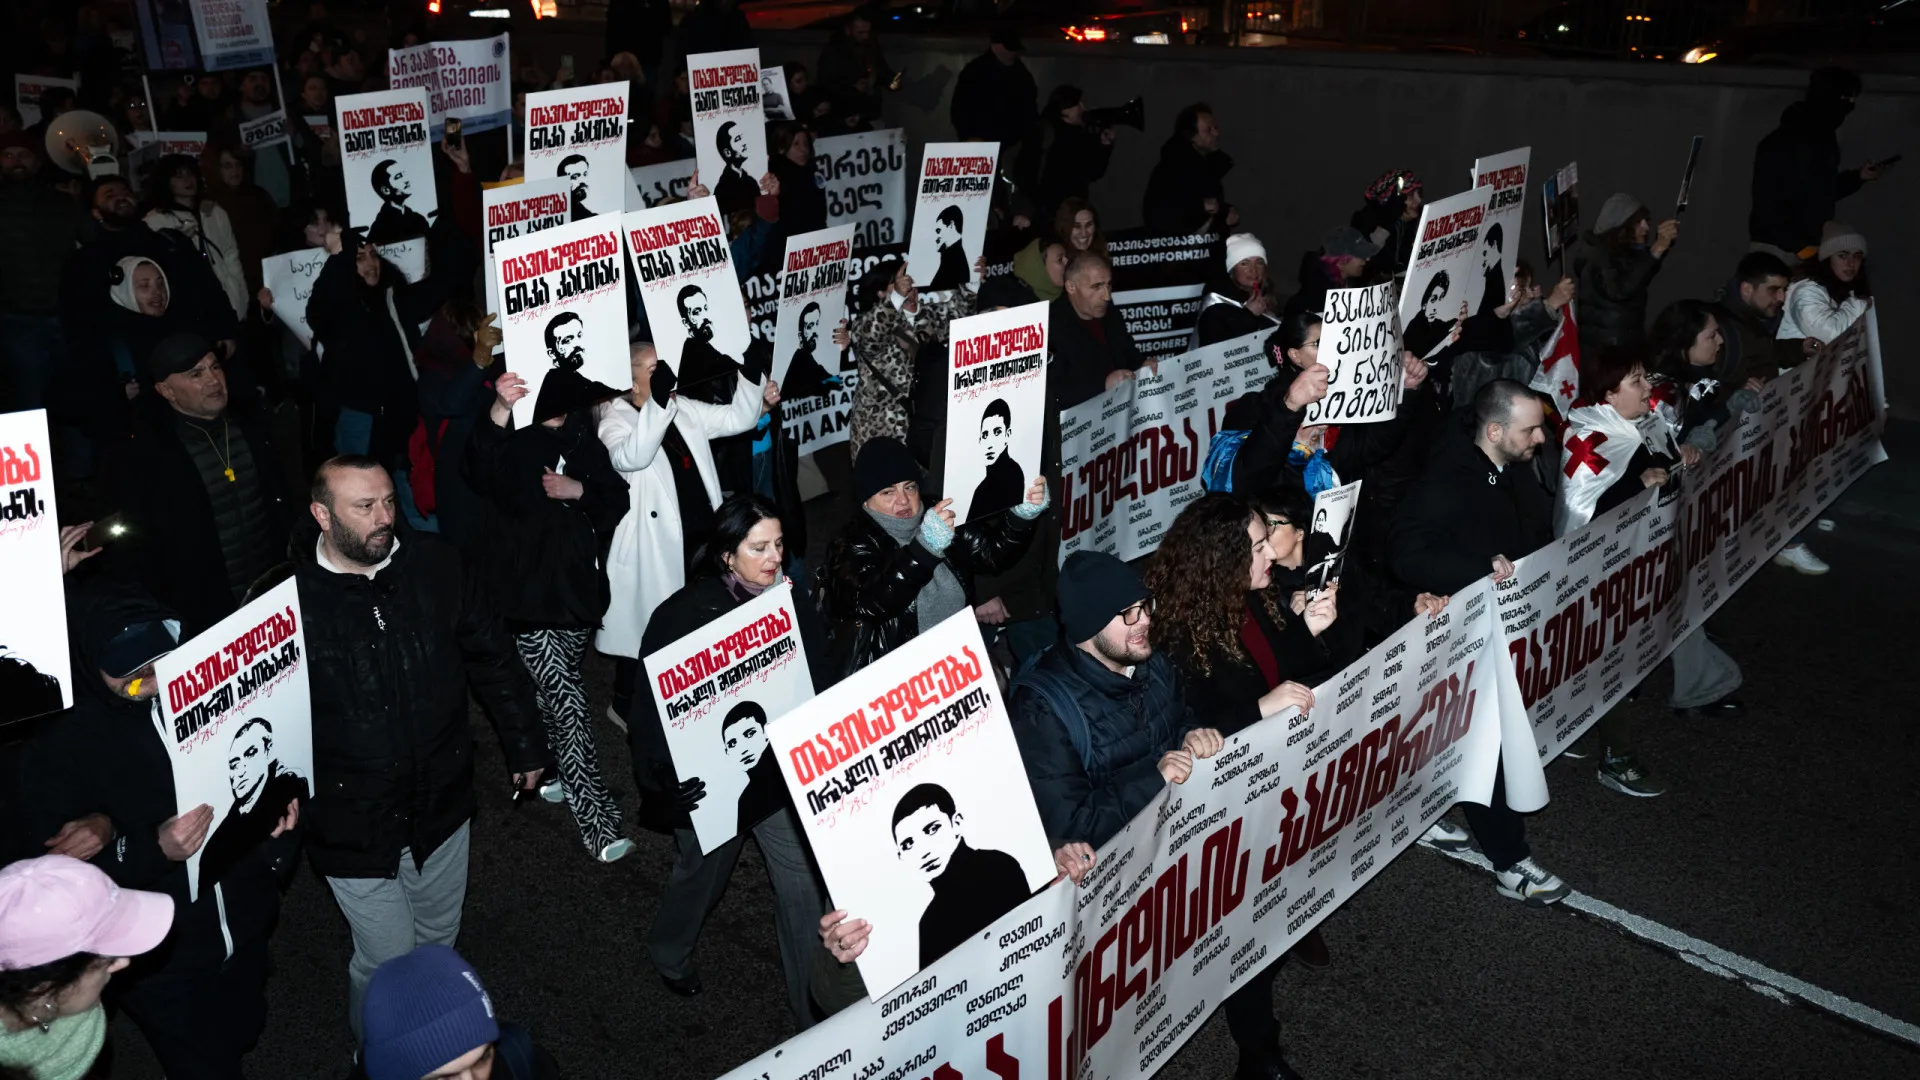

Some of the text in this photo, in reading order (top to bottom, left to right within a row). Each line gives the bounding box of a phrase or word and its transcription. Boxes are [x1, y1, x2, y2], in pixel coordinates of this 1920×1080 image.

[392, 53, 409, 76] არ
[441, 64, 501, 88] რეჟიმის
[692, 63, 759, 89] თავისუფლება
[343, 101, 425, 131] თავისუფლება
[530, 96, 625, 127] თავისუფლება
[694, 90, 720, 112] მათე
[344, 130, 376, 153] მათე
[530, 125, 566, 150] ნიკა
[925, 156, 994, 176] თავისუფლება
[828, 183, 882, 217] ბელ
[922, 177, 954, 193] გიორგი
[488, 192, 567, 227] თავისუფლება
[1422, 203, 1486, 243] თავისუფლება
[630, 213, 721, 254] თავისუფლება
[502, 231, 618, 284] თავისუფლება
[637, 250, 676, 282] ნიკა
[787, 238, 850, 272] თავისუფლება
[1111, 249, 1211, 267] REEDOMFORMZIA
[505, 277, 550, 315] ნიკა
[784, 270, 809, 298] ნიკა
[1125, 318, 1172, 334] რებს!
[954, 322, 1044, 369] თავისუფლება
[1135, 337, 1188, 353] RISONERS
[1224, 345, 1250, 359] ფრიდონ
[954, 366, 988, 390] ირაკლი
[1185, 360, 1202, 372] დავით
[1186, 368, 1214, 384] კოლდარი
[1138, 375, 1164, 388] გიორგი
[1174, 388, 1196, 402] დანიელ
[1213, 376, 1231, 388] რეზო
[781, 394, 836, 422] UMELEBI
[1061, 417, 1198, 541] სუფლება
[1138, 521, 1162, 537] ირაკლი
[1425, 613, 1450, 636] გიორგი
[1509, 530, 1684, 709] თავისუფლება
[657, 606, 792, 700] თავისუფლება
[1384, 640, 1407, 663] ანტონ
[1426, 629, 1452, 654] მინდაძე
[168, 605, 297, 714] თავისუფლება
[1338, 666, 1371, 698] ანატოლი
[1372, 682, 1398, 706] ანდრო
[174, 683, 234, 743] გიორგი
[666, 679, 717, 721] ირაკლი
[789, 645, 983, 786] თავისუფლება
[1286, 723, 1316, 748] დევიძე
[1305, 729, 1330, 755] ვასილ
[1214, 743, 1251, 772] ანდრეი
[1262, 659, 1477, 884] პატიმრებს
[807, 754, 880, 816] ირაკლი
[1244, 776, 1281, 804] კასრაძე
[1247, 762, 1279, 788] ვეფხია
[1168, 807, 1227, 857] მიმინოშვილი
[1169, 803, 1206, 838] ირაკლი
[1357, 811, 1373, 828] ნიკა
[1391, 814, 1405, 832] საბა
[1307, 849, 1337, 879] ახობაძე
[1310, 836, 1339, 863] გიორგი
[1350, 834, 1381, 866] თორნიკე
[1351, 855, 1375, 882] გოშაძე
[1103, 880, 1121, 907] მზია
[1252, 888, 1288, 924] დავითაძე
[1253, 877, 1282, 908] გიორგი
[1286, 886, 1316, 919] ვალერი
[1287, 888, 1336, 936] თეთრაშვილი
[999, 915, 1043, 950] დავით
[1000, 922, 1066, 972] კოლდარი
[1193, 925, 1223, 959] გიორგი
[1048, 816, 1251, 1080] სინდისის
[1230, 938, 1256, 966] დავით
[1229, 944, 1268, 984] ხომერიკი
[881, 976, 937, 1019] გიორგი
[966, 974, 1024, 1015] დანიელ
[1136, 984, 1161, 1016] დავით
[882, 979, 968, 1042] კუჭუაშვილი
[966, 994, 1027, 1037] მუმლაძე
[1139, 1013, 1172, 1054] ირაკლი
